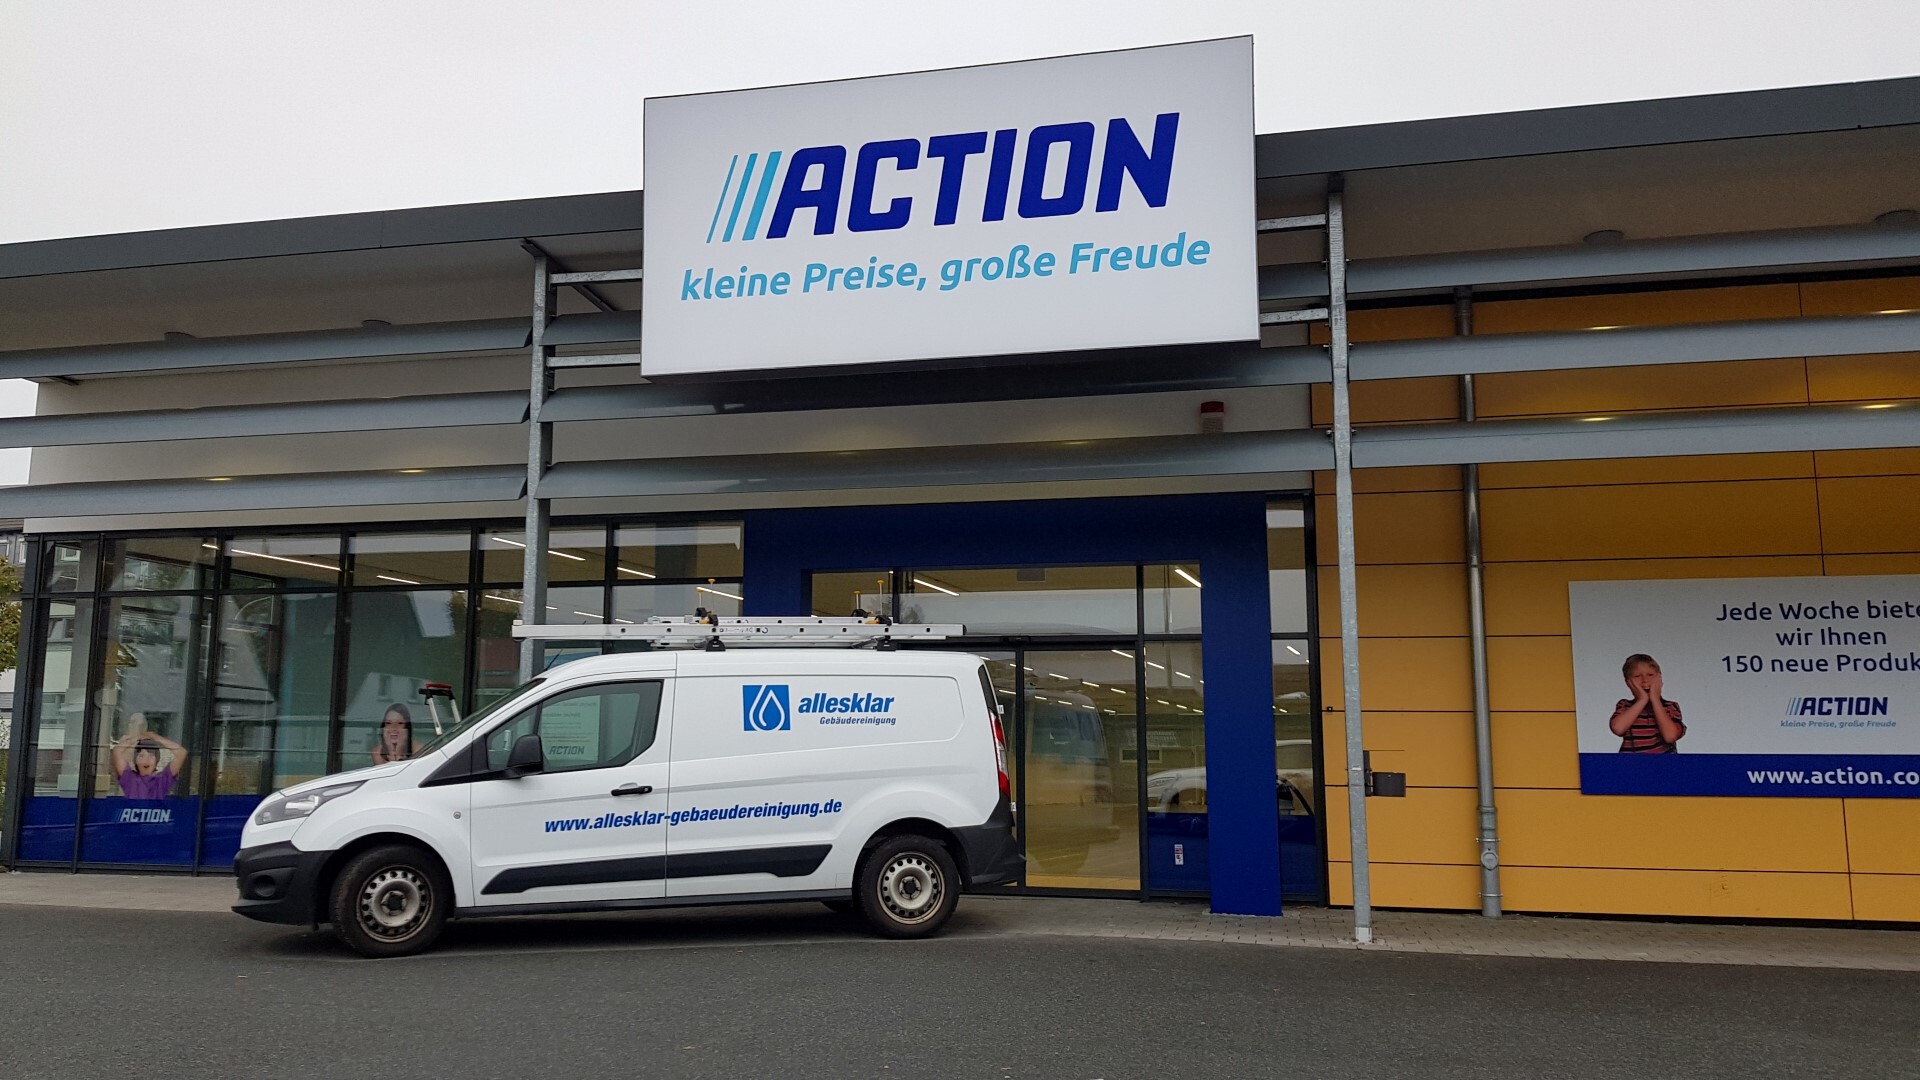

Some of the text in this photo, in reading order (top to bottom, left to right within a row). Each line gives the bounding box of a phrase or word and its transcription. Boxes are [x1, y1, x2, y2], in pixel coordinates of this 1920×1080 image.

[766, 112, 1180, 239] ACTION
[681, 232, 1210, 300] kleine Preise, große Freude
[1716, 602, 1772, 621] Jede
[1779, 601, 1859, 620] Woche
[1776, 627, 1887, 646] wir Ihnen
[1722, 652, 1920, 673] 150 neue Produk
[798, 693, 895, 714] allesklar
[1799, 697, 1889, 716] ACTION
[820, 716, 897, 726] Gebäudereinigung
[1780, 720, 1807, 728] kleine
[1866, 720, 1897, 728] Freude
[548, 745, 585, 755] ACTION
[1747, 767, 1920, 785] www.action.co
[120, 808, 172, 823] ACTION
[545, 799, 843, 833] www.allesklar-gebaeudereinigung.de
